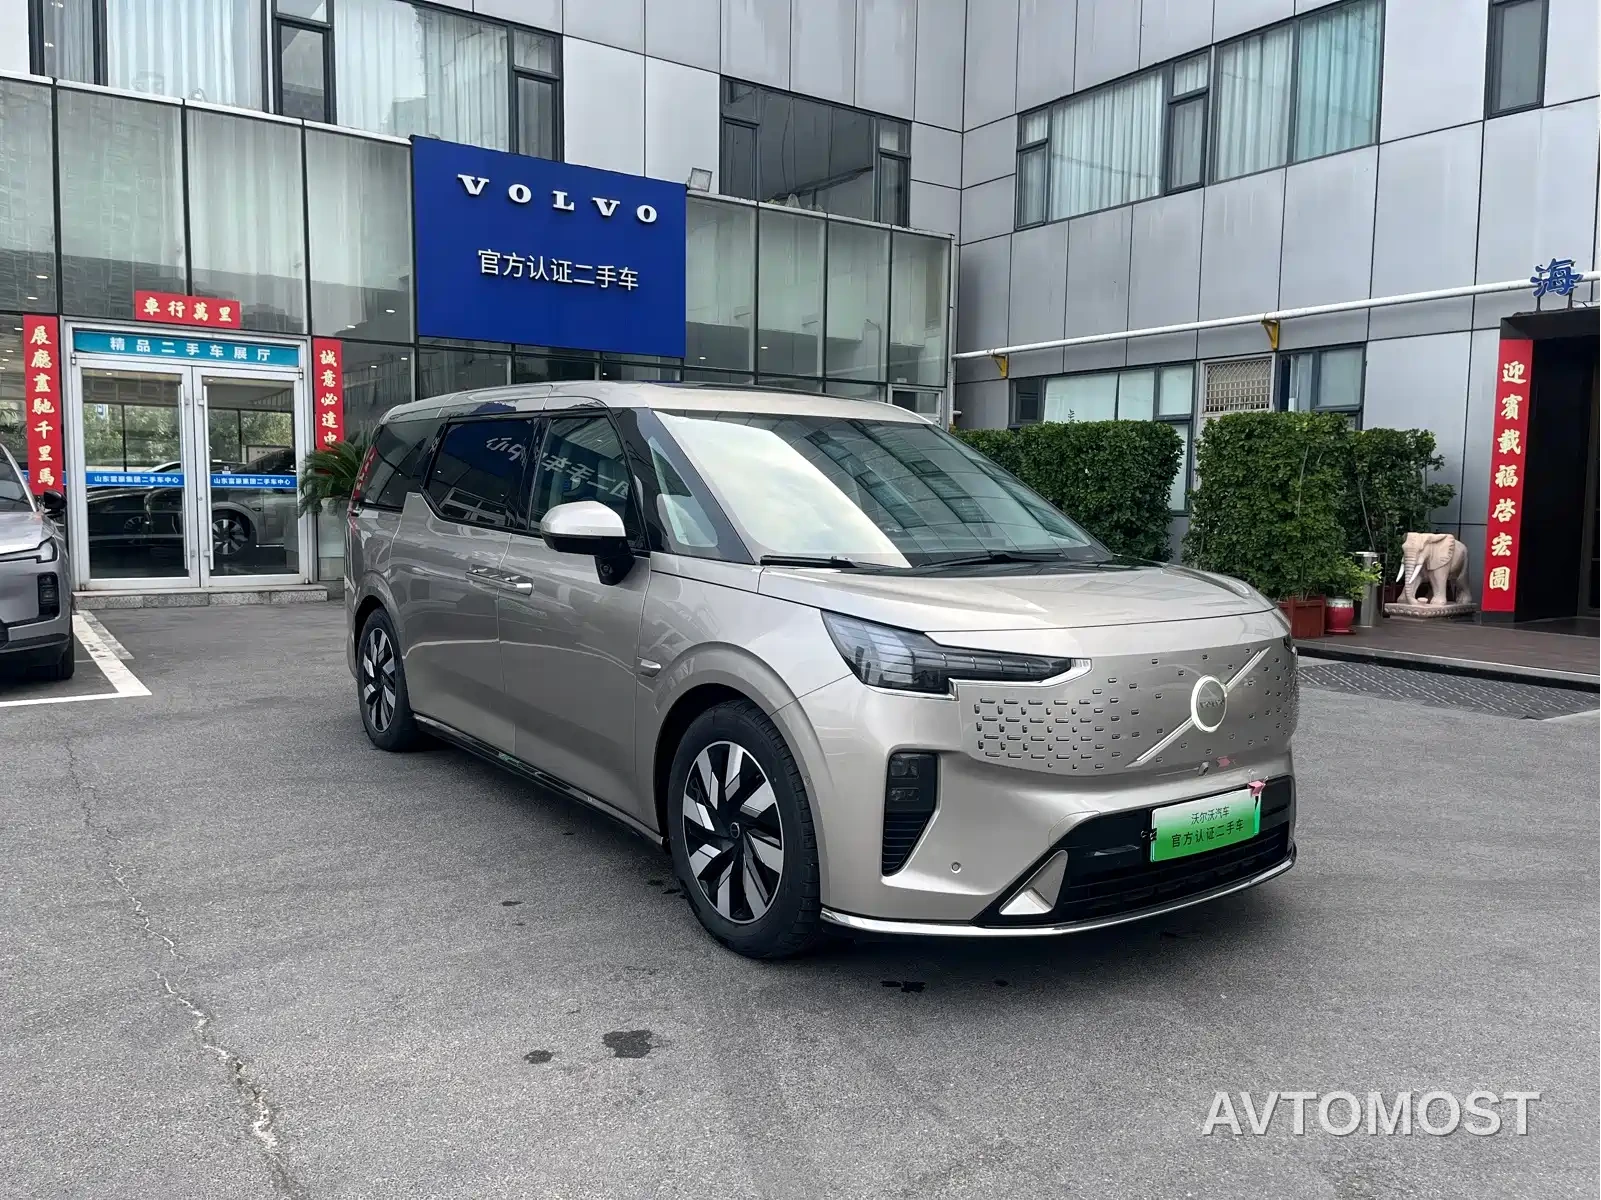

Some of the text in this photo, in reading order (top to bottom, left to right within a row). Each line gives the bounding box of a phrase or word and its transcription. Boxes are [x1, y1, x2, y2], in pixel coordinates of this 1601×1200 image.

[457, 173, 658, 224] VOLVO
[478, 248, 639, 291] 官方认证二手车
[1529, 257, 1584, 297] 海
[143, 296, 233, 323] 車行萬里
[109, 336, 271, 362] 精品二手车展厅
[1190, 805, 1230, 825] 沃尔沃汽车
[1171, 819, 1244, 848] 官方认证二手车
